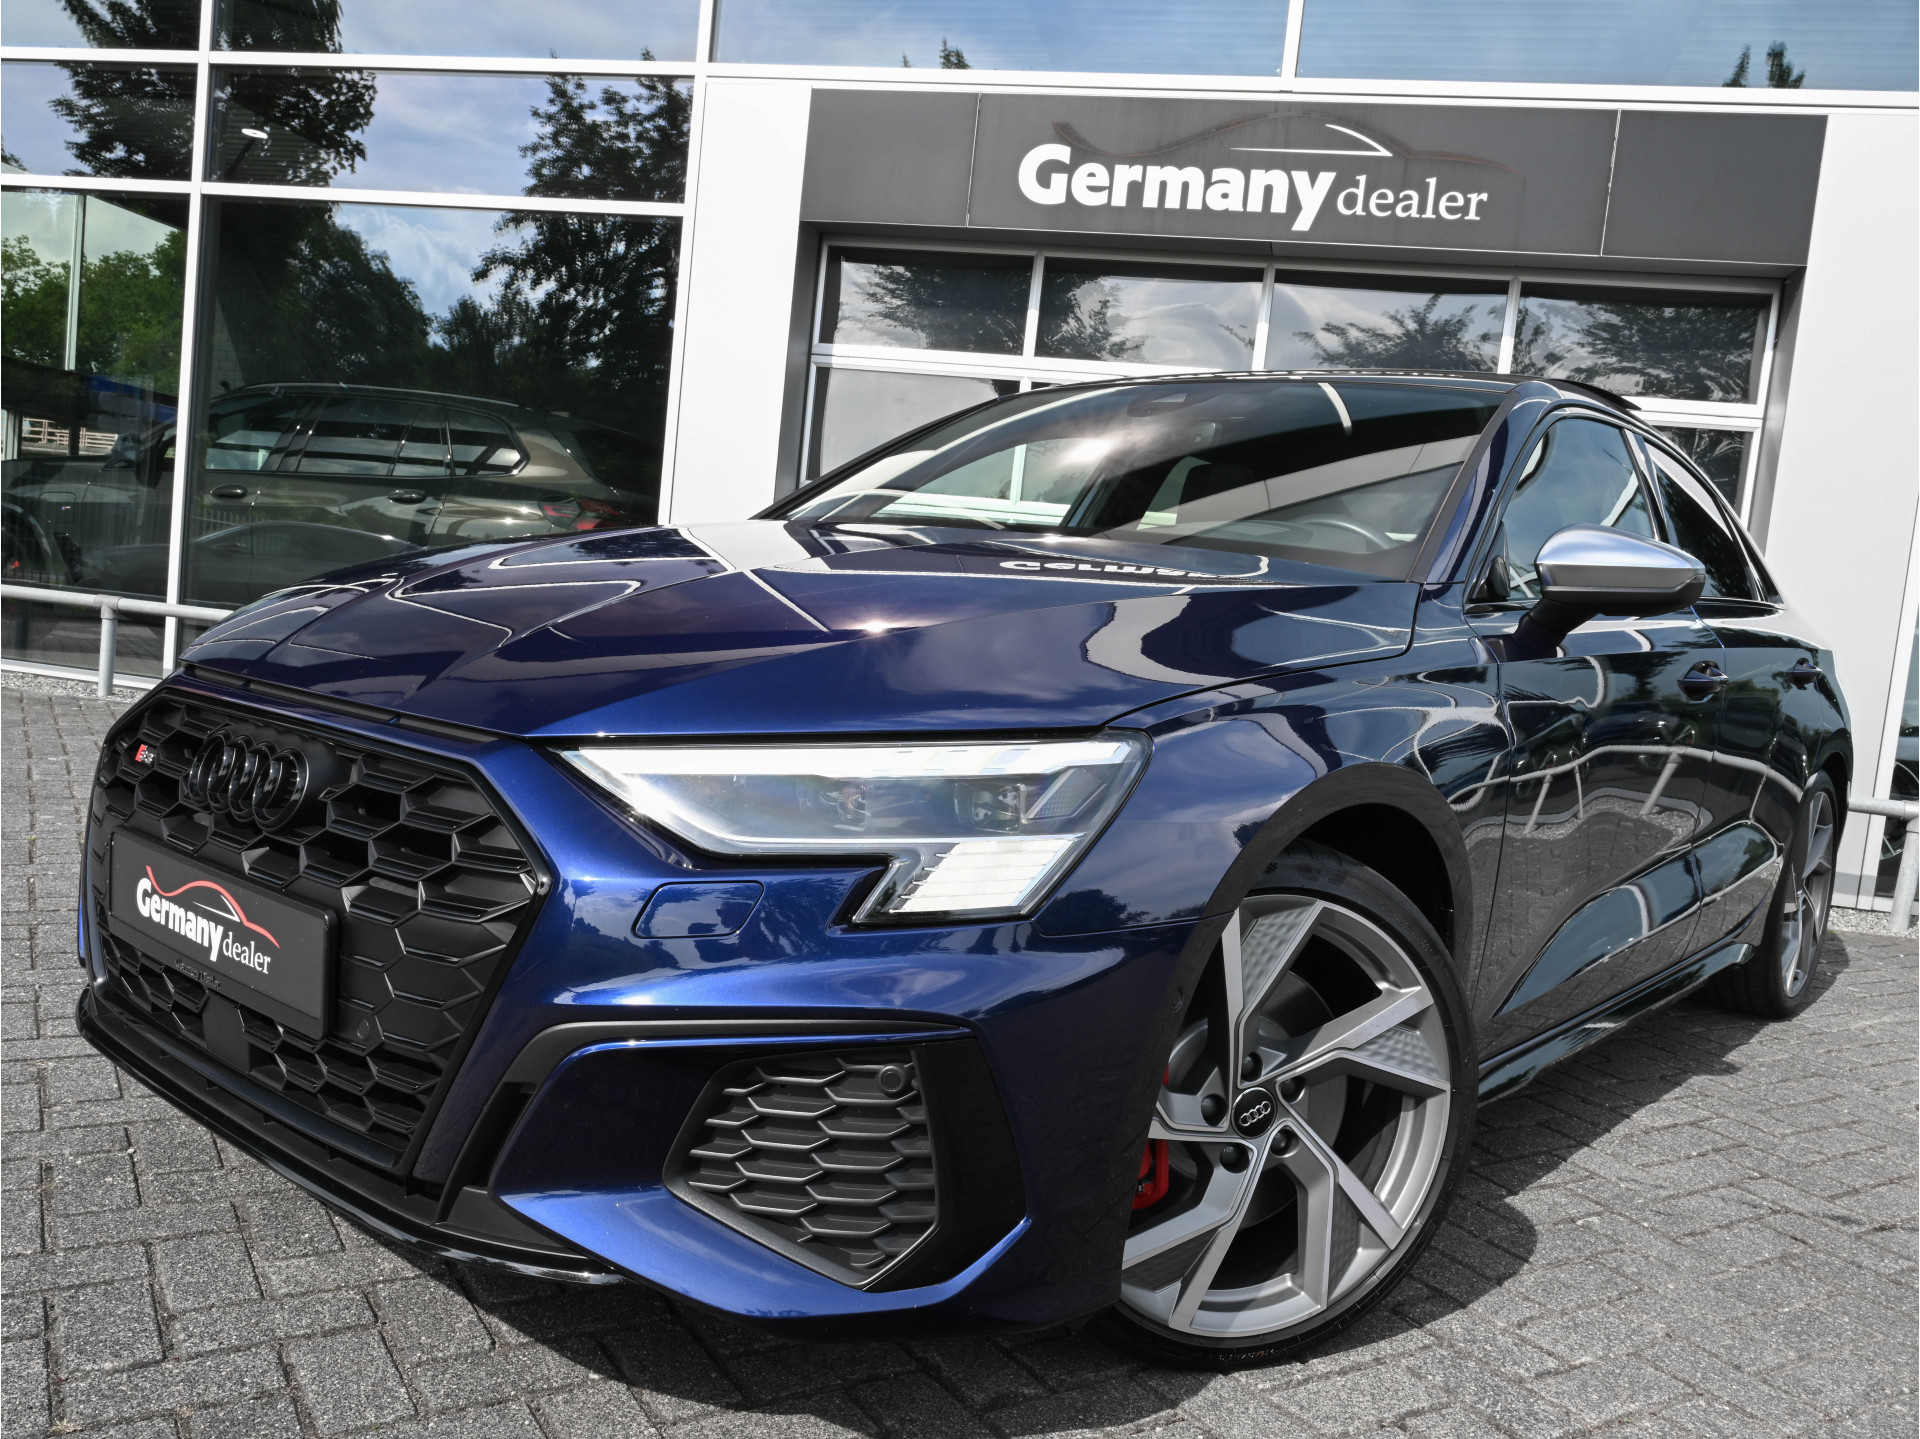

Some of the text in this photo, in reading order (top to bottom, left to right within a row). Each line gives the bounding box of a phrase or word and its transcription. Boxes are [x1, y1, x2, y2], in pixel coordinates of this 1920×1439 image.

[1017, 143, 1489, 232] Germany dealer
[136, 877, 272, 975] Germany dealer
